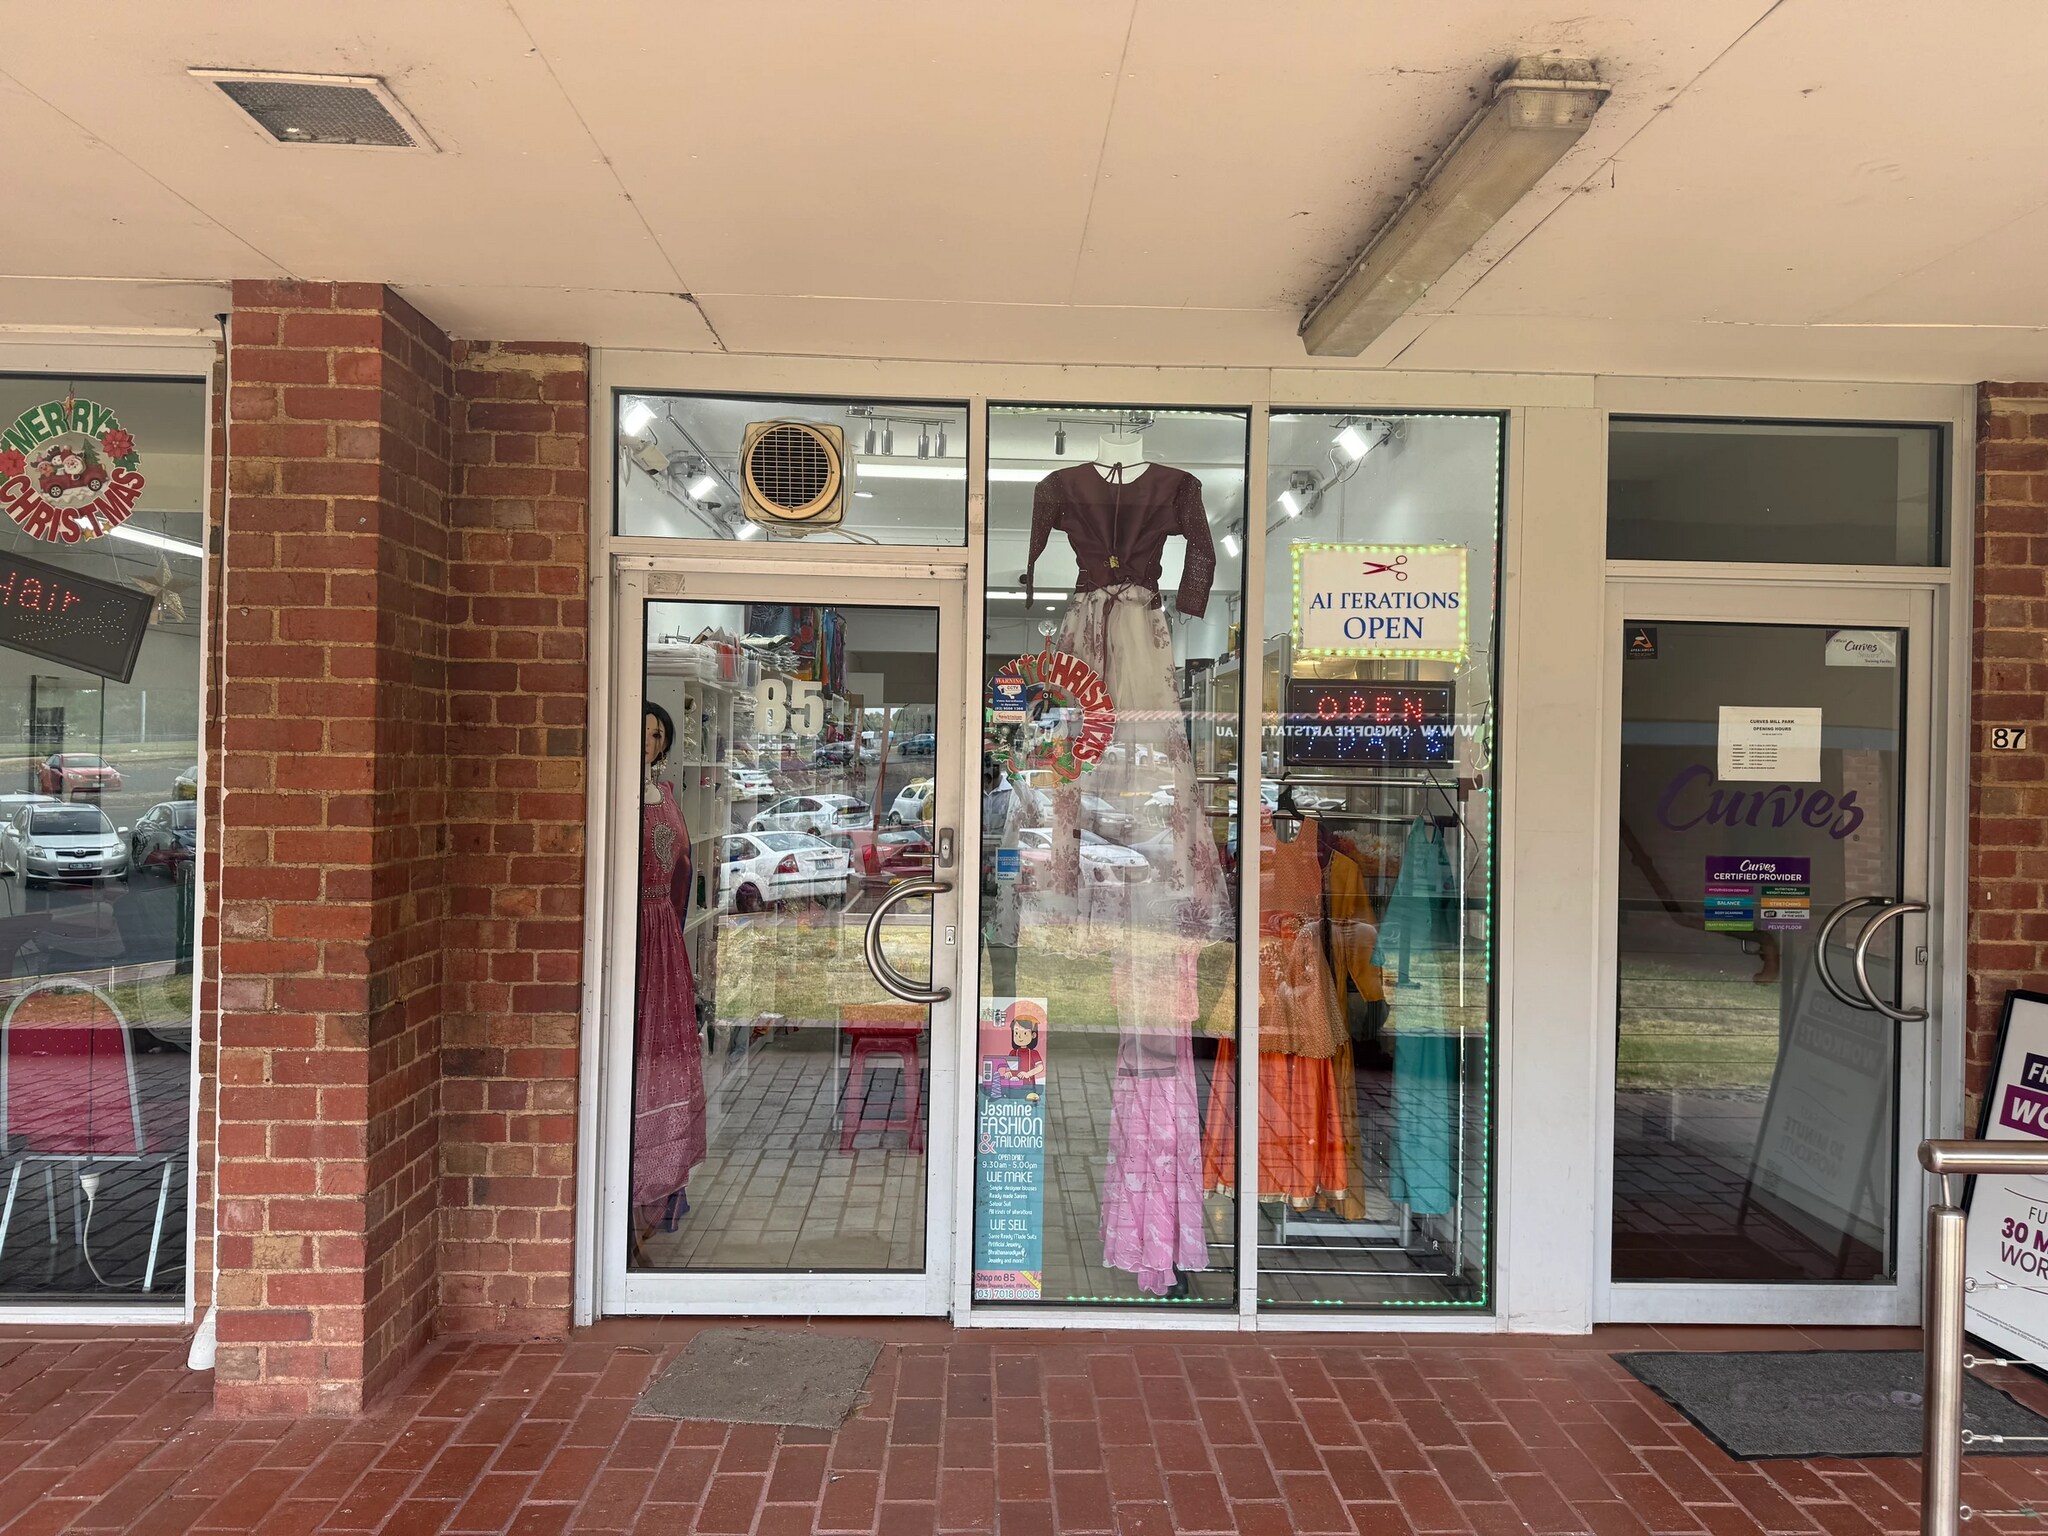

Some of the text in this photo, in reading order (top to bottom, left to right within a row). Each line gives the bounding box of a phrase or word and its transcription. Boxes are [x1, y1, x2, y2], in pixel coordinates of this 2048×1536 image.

[3, 398, 115, 455] MERRY
[0, 467, 145, 543] CHRISTMAS
[1343, 617, 1424, 640] OPEN
[1844, 640, 1878, 652] Curves
[754, 677, 824, 737] 85
[1036, 651, 1117, 765] CHRISTMAS
[1317, 696, 1423, 723] OPEN
[1994, 728, 2025, 748] 87
[1657, 764, 1864, 840] Curves
[1740, 859, 1776, 873] Curves
[1759, 873, 1802, 881] PROVIDER
[980, 1099, 1032, 1116] Jasmine
[980, 1117, 1043, 1135] FASHION
[978, 1132, 1043, 1154] & TAILORING
[982, 1161, 1007, 1169] 9.30am
[1012, 1161, 1038, 1170] 5.00pm
[986, 1171, 1033, 1182] WE MAKE
[990, 1219, 1028, 1231] WE SELL
[2001, 1217, 2029, 1243] 30
[976, 1272, 993, 1283] Shop
[1003, 1273, 1016, 1282] 85
[975, 1289, 1041, 1299] (03) 7018 0005
